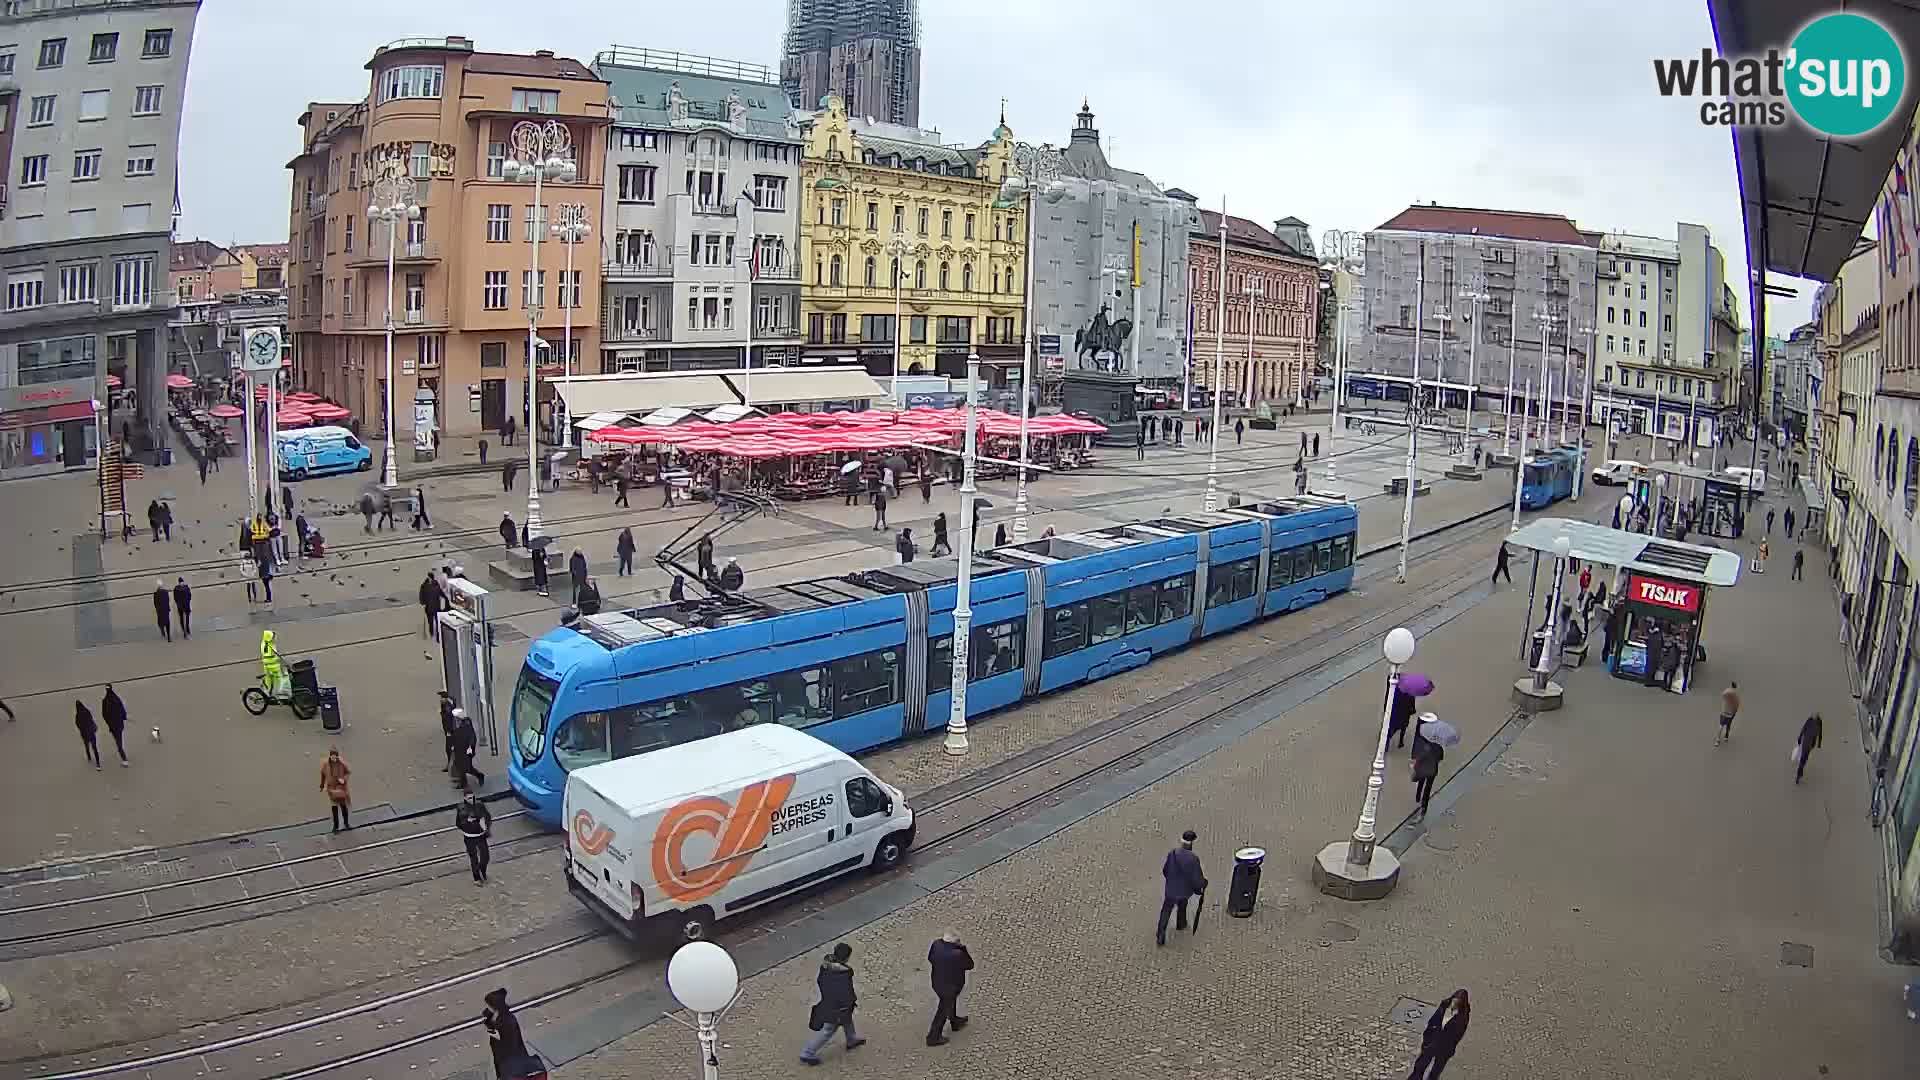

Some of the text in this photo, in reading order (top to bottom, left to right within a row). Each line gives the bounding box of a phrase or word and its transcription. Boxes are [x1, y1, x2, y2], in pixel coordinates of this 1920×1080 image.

[1641, 582, 1689, 606] TISAK
[771, 794, 834, 822] OVERSEAS
[771, 809, 826, 836] EXPRESS
